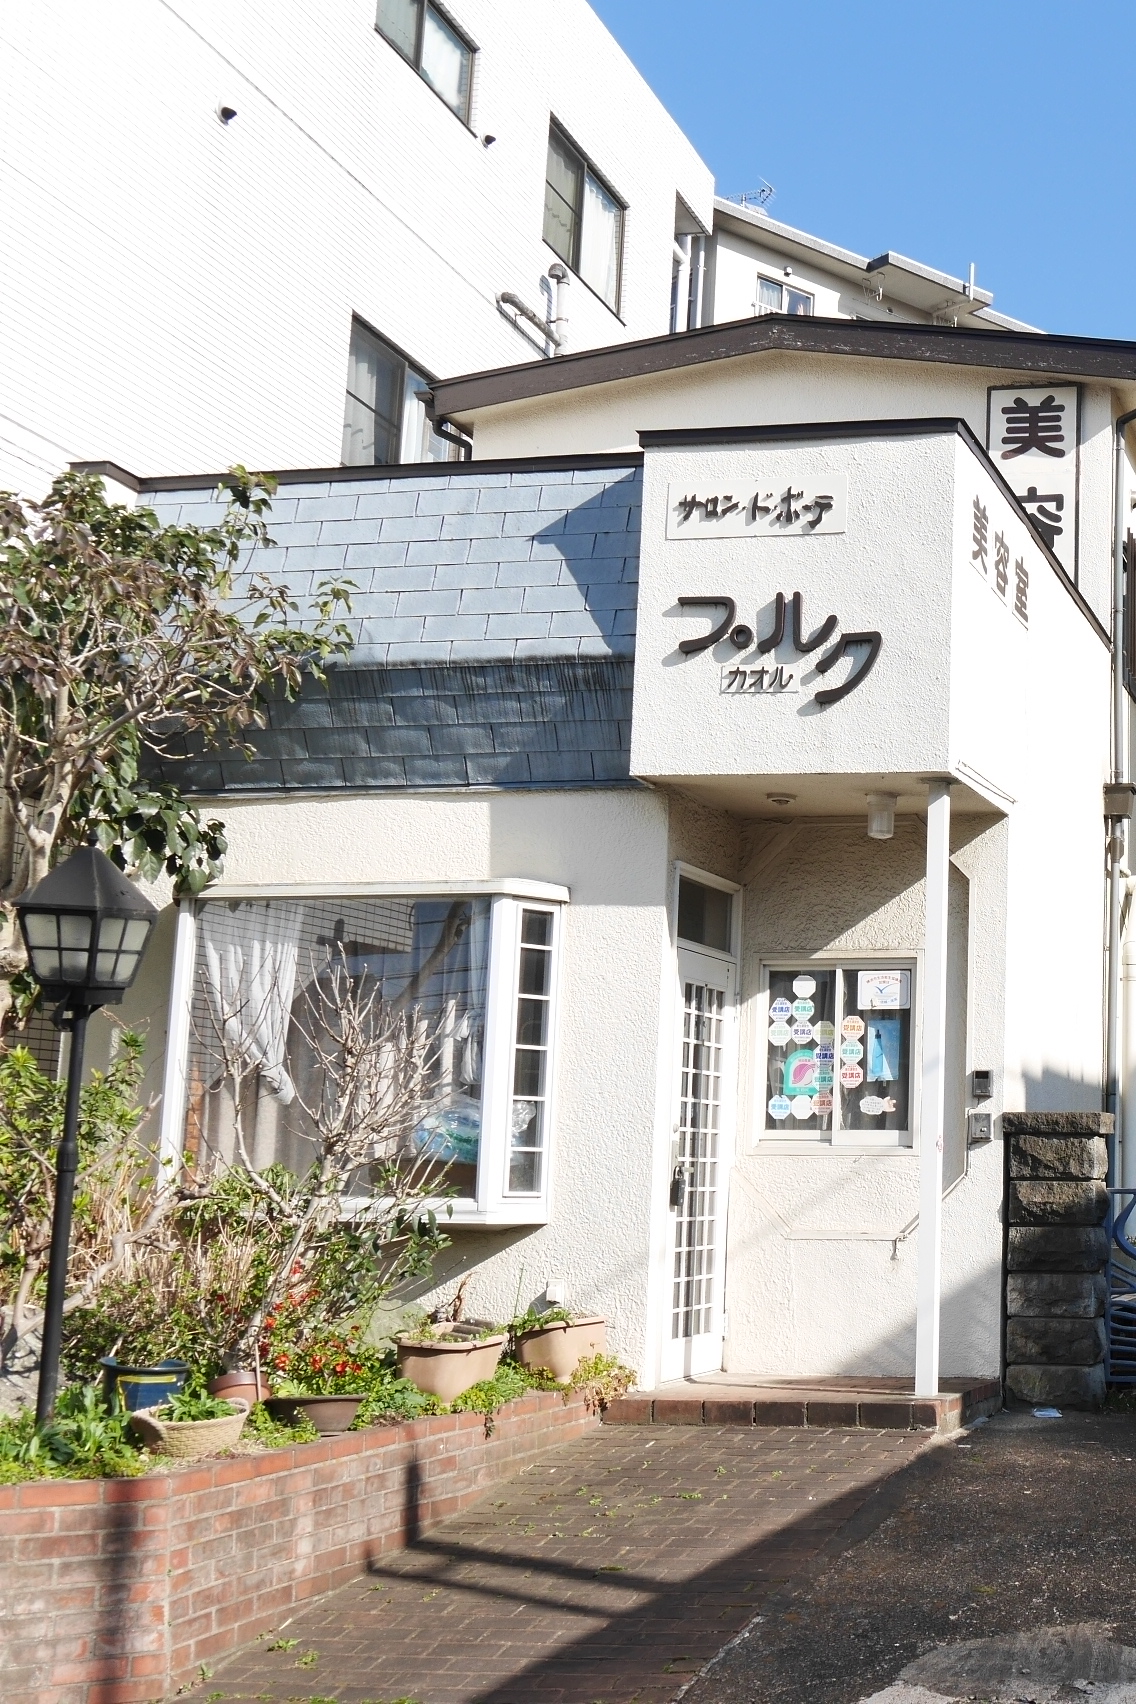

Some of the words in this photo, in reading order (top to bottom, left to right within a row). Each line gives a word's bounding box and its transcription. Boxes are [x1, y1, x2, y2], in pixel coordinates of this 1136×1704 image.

[971, 494, 1029, 623] 美容室
[677, 591, 883, 704] プルク
[727, 665, 794, 690] カオル
[771, 1006, 790, 1014] 受講店
[794, 1005, 813, 1013] 受講店
[842, 1024, 862, 1032] 受講店
[815, 1052, 835, 1060] 受講店
[841, 1048, 861, 1056] 受講店
[841, 1072, 861, 1080] 受講店
[770, 1103, 790, 1111] 受講店
